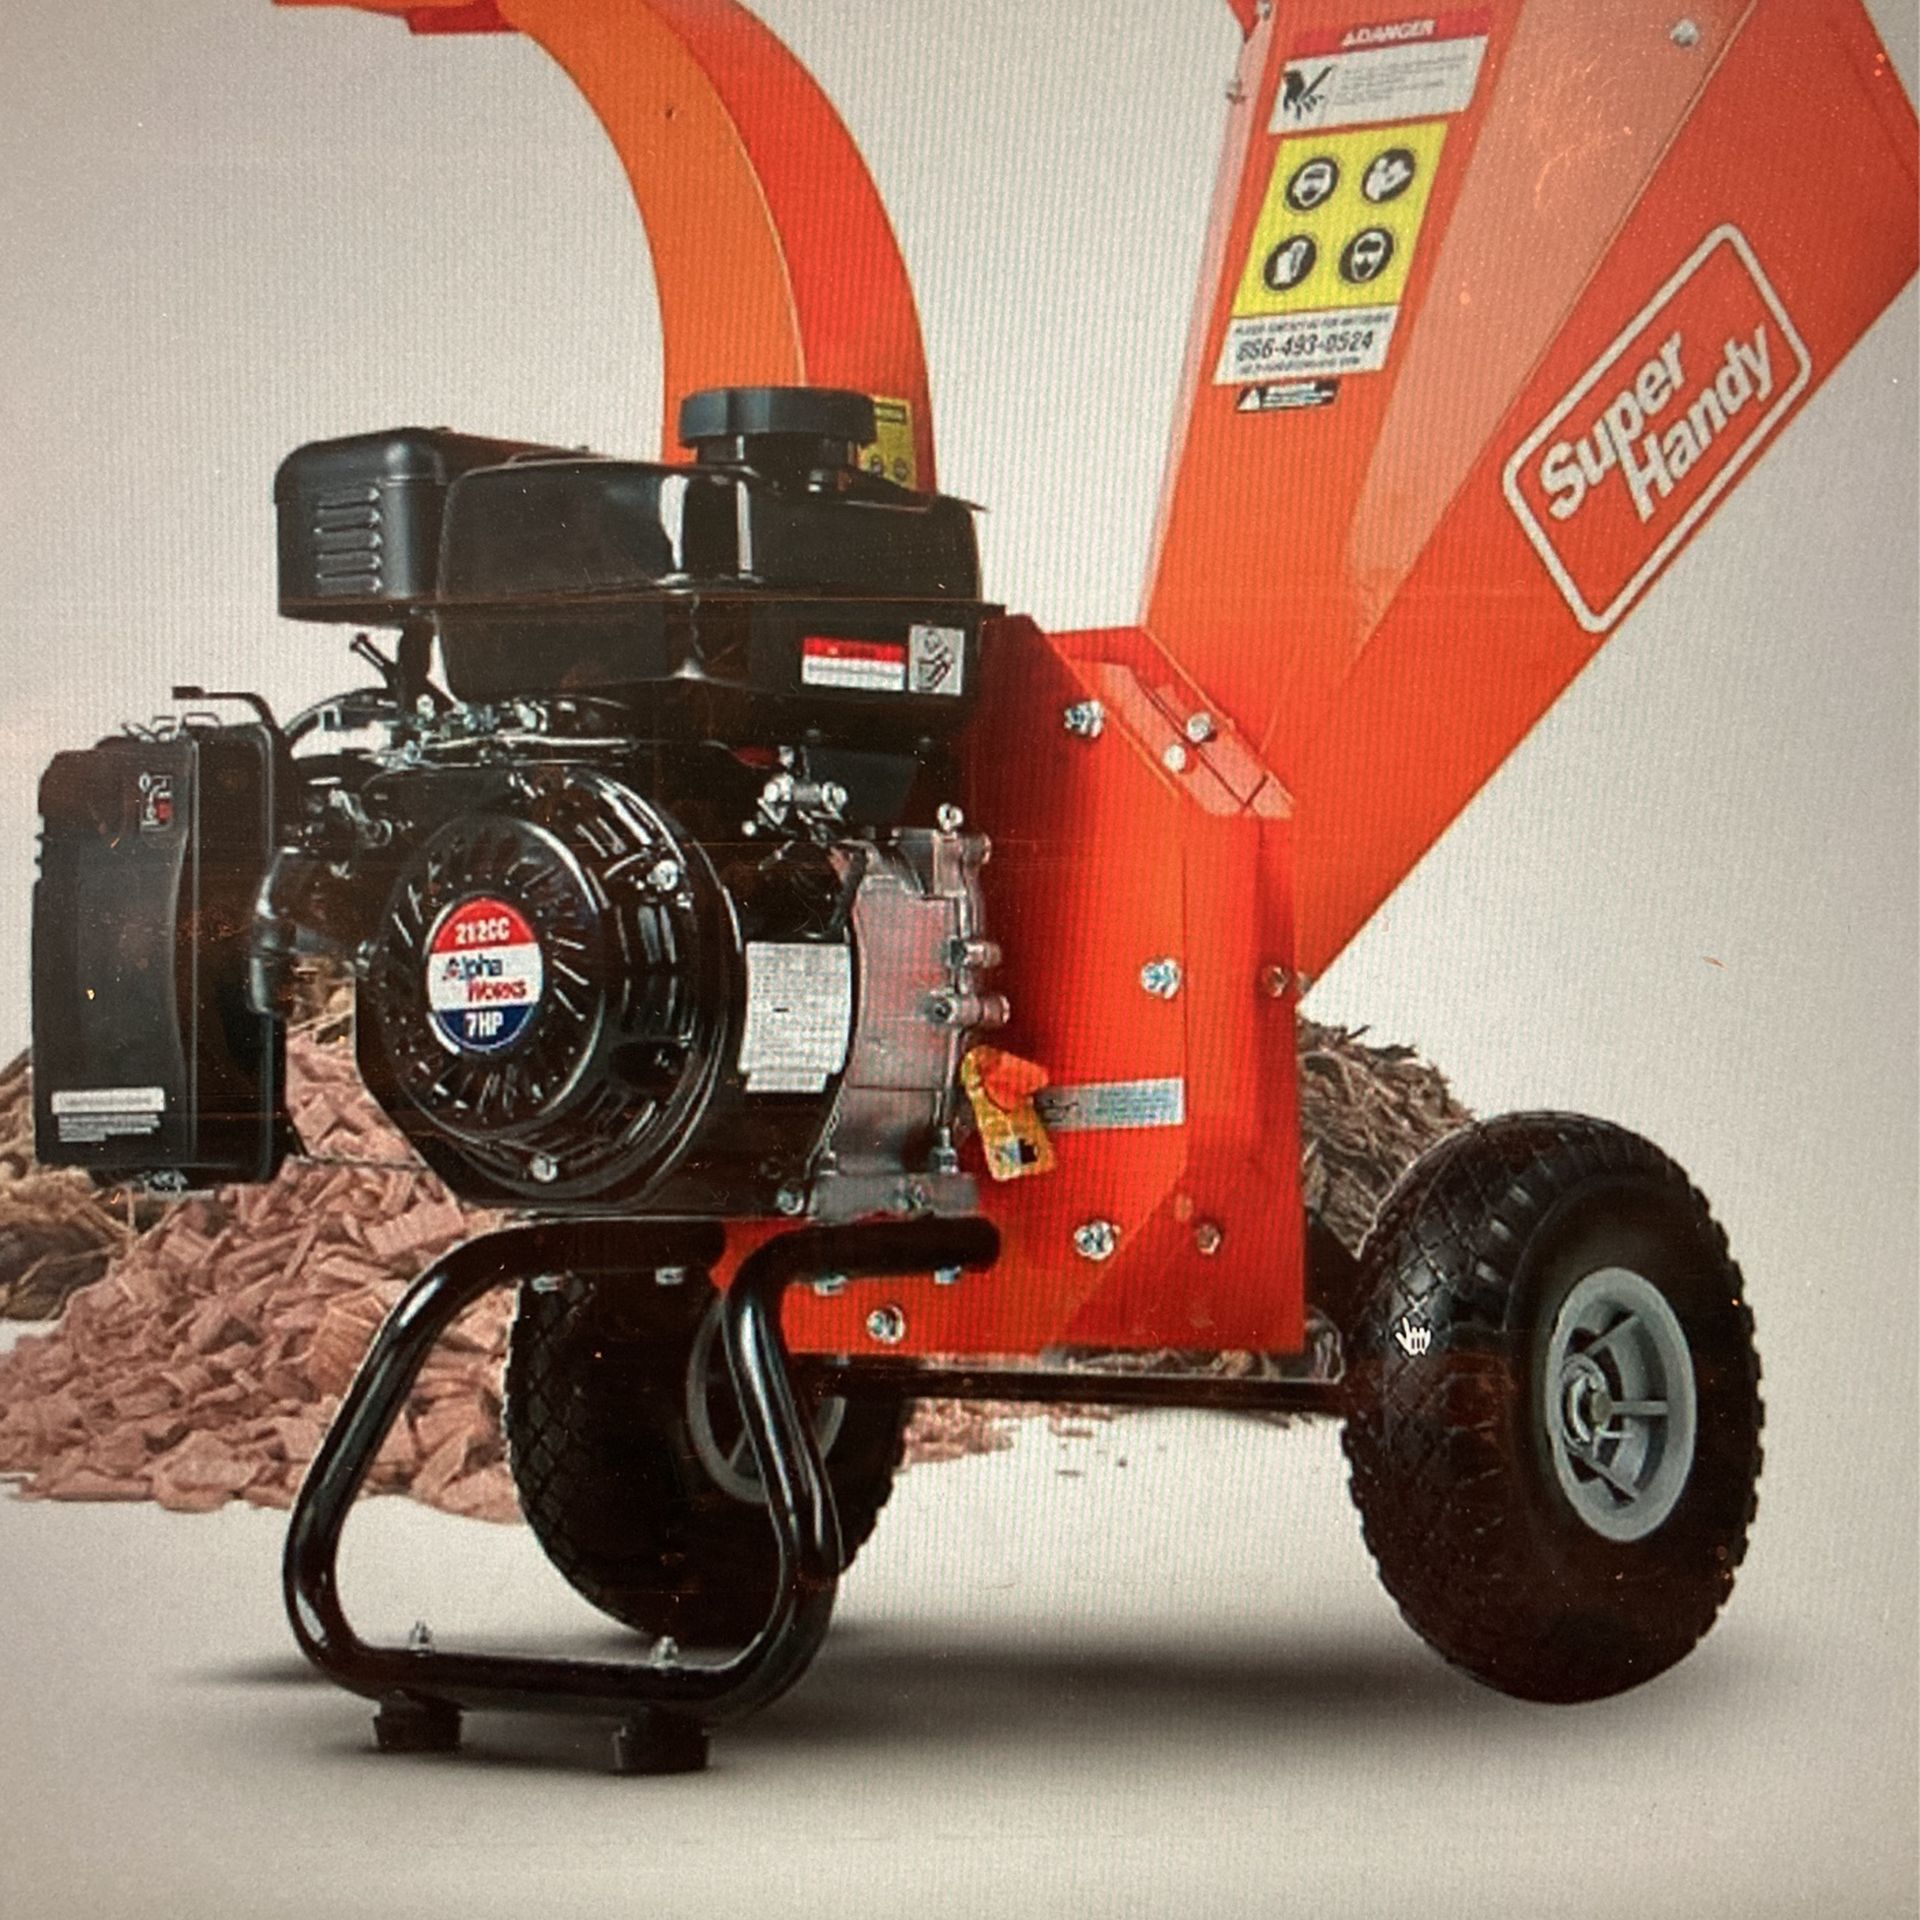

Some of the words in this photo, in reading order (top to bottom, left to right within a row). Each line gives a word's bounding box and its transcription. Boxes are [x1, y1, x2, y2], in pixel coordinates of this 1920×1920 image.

[1355, 19, 1436, 45] DANGER
[1539, 330, 1686, 520] Super
[1620, 320, 1774, 523] Handy
[454, 917, 511, 945] 212CC
[465, 1011, 504, 1038] 7HP
